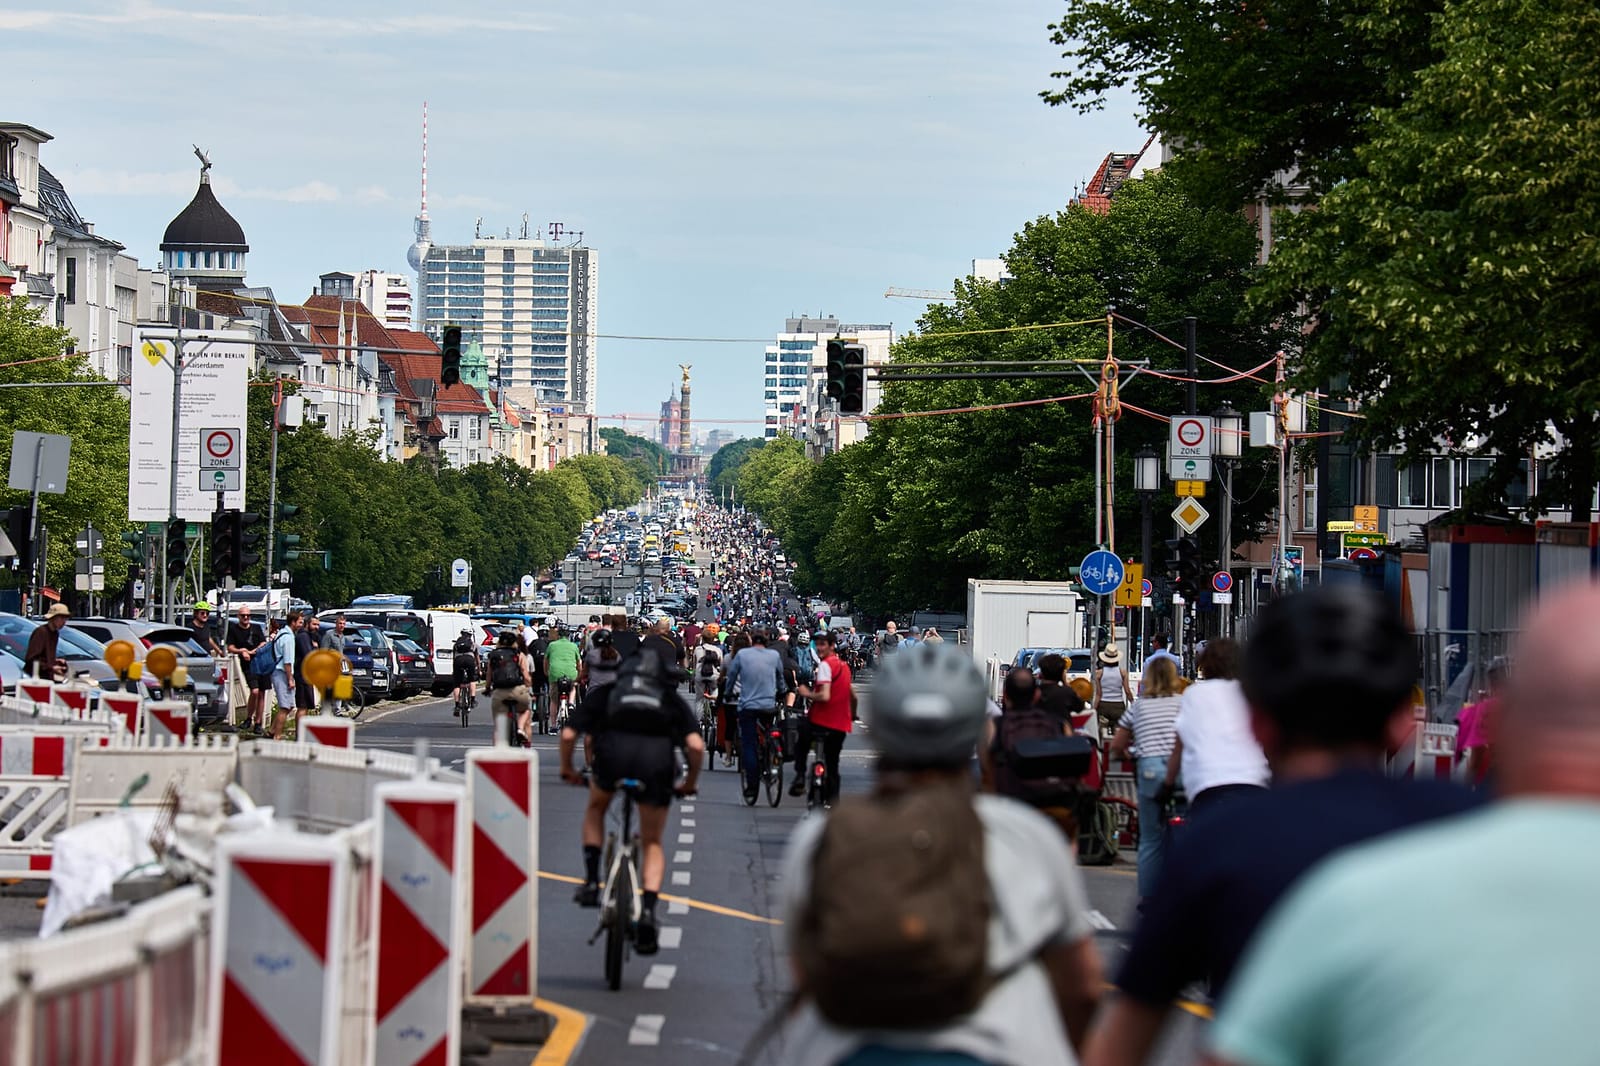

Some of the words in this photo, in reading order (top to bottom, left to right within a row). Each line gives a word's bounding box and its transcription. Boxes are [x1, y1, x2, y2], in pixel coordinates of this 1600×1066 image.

[577, 256, 585, 327] TECHNISCHE
[1363, 509, 1369, 518] 2
[1363, 522, 1369, 531] 5
[1125, 573, 1134, 584] U
